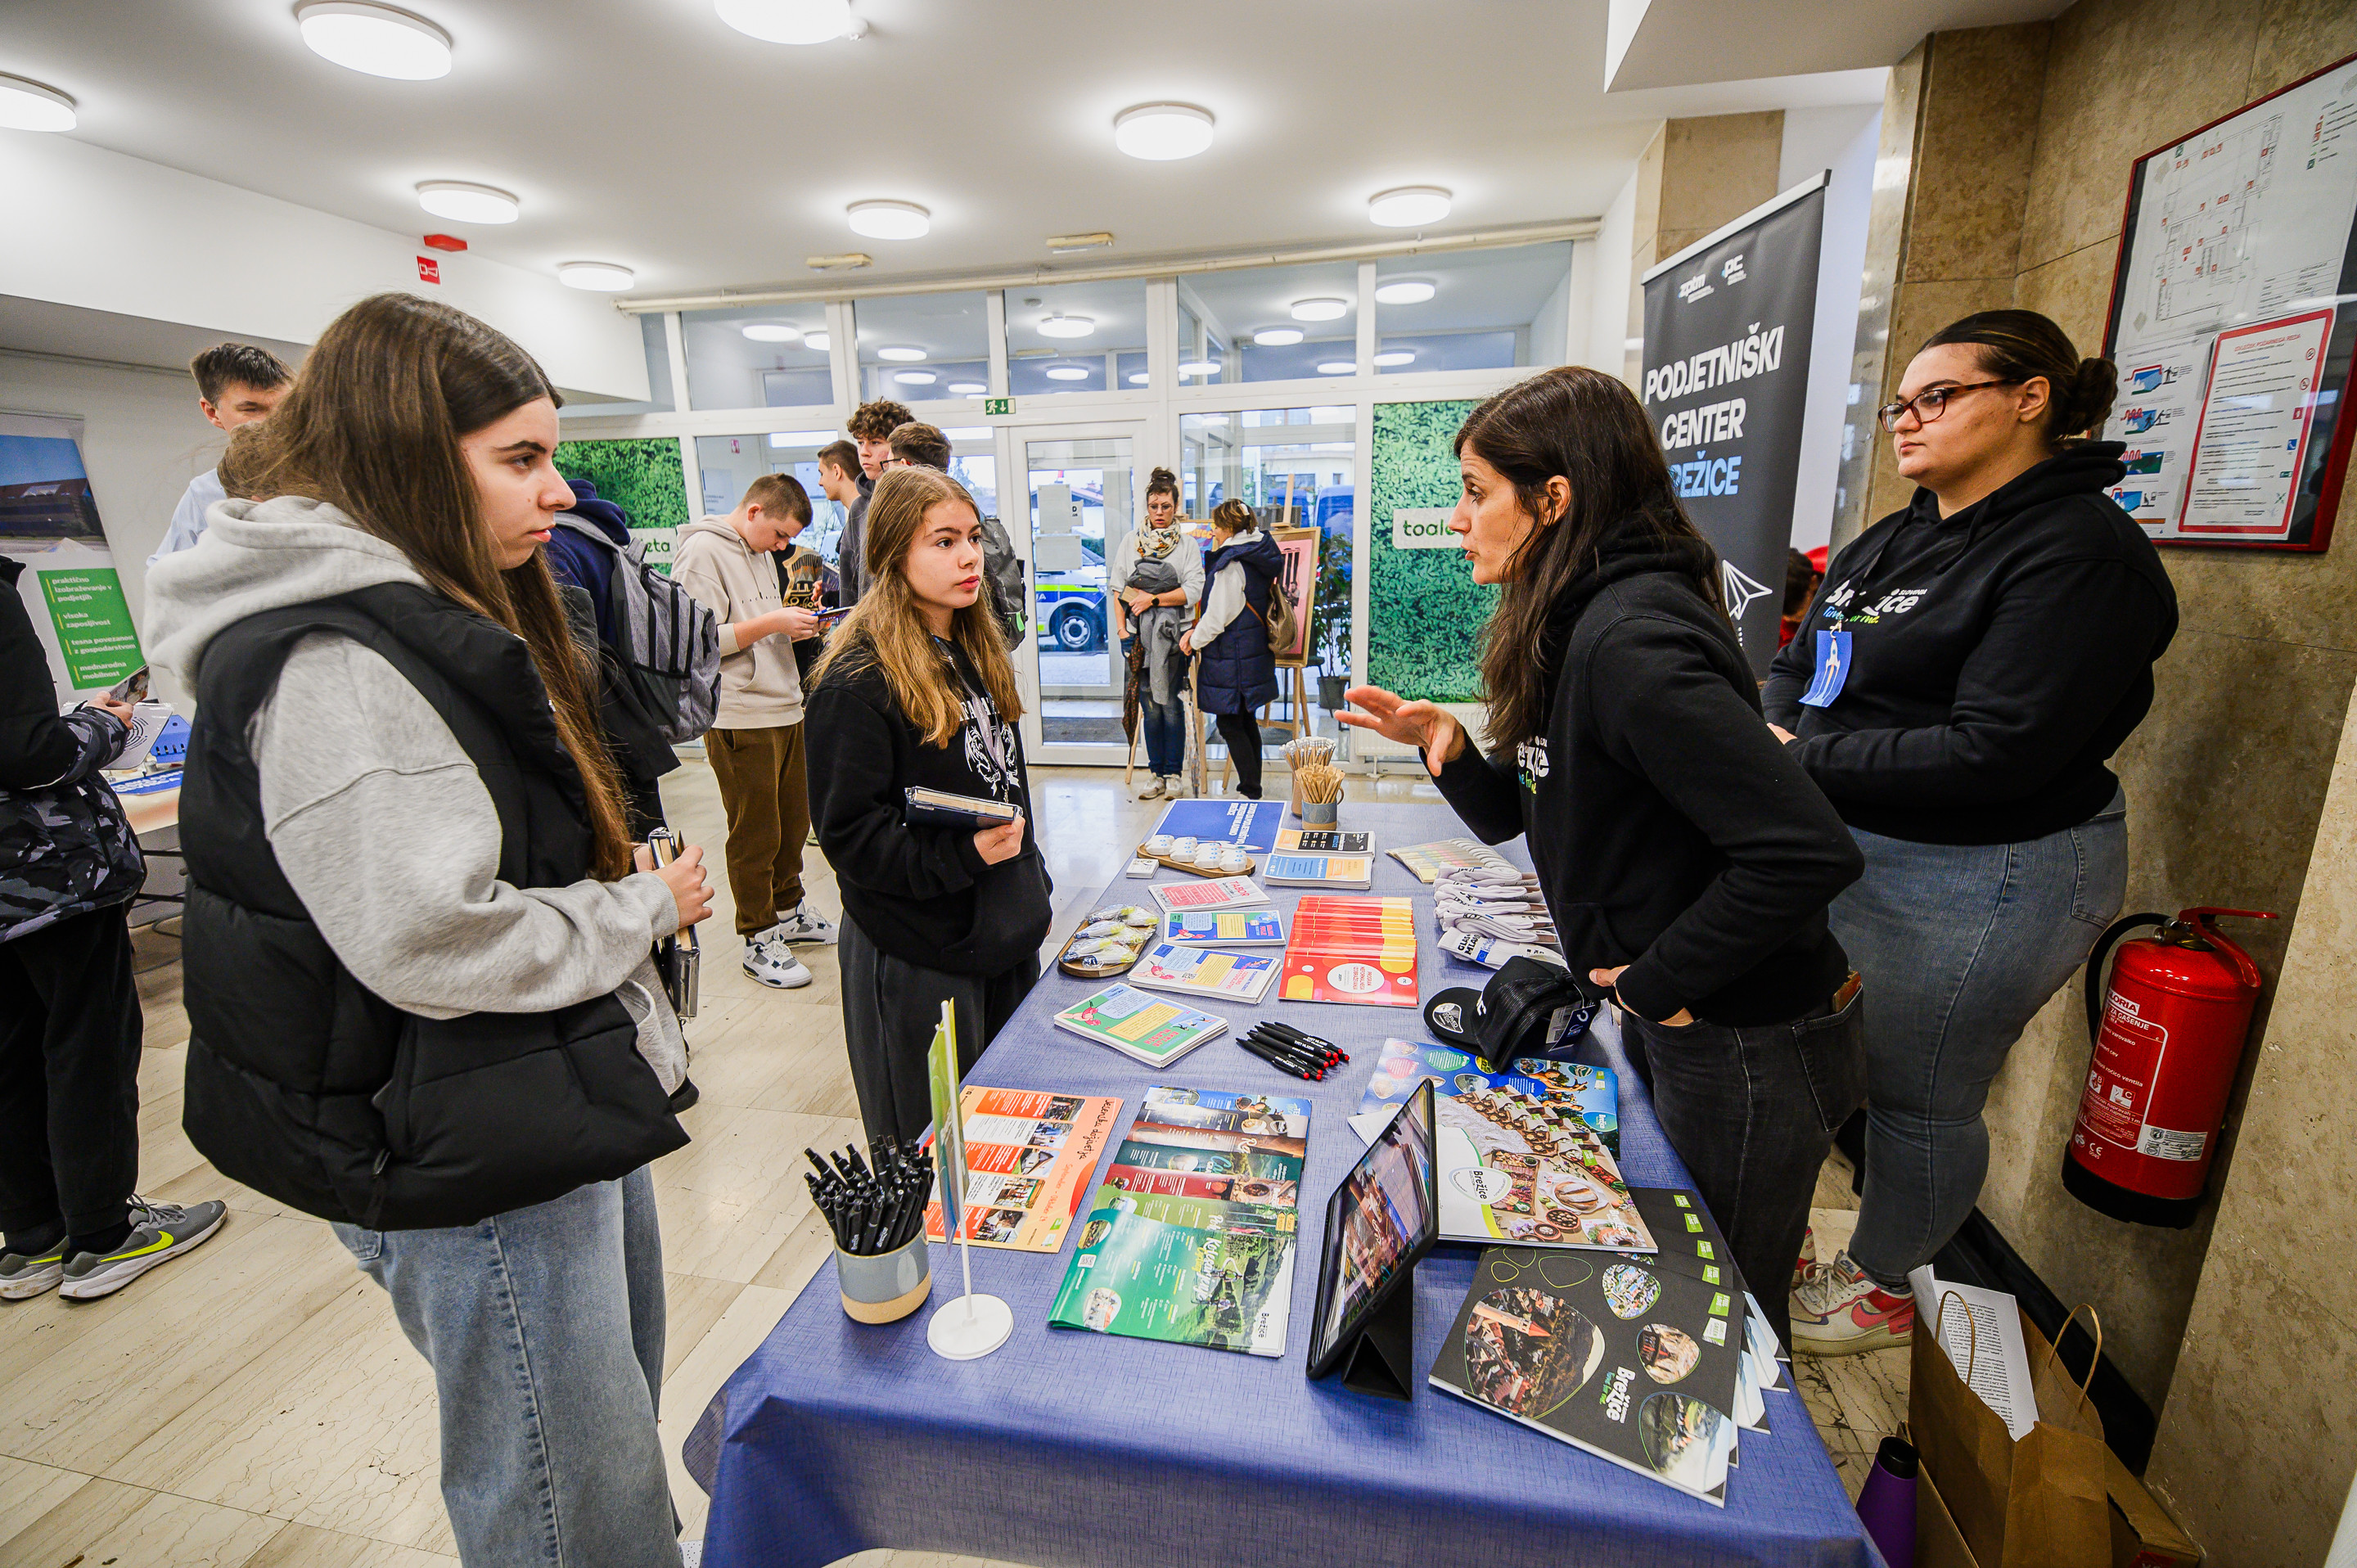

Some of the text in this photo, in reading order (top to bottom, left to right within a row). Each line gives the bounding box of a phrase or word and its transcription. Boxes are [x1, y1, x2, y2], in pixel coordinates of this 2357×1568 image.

[1645, 322, 1785, 405] PODJETNIŠKI
[1661, 398, 1746, 450] CENTER
[1669, 450, 1742, 498] REŽICE
[1403, 518, 1458, 536] toale
[52, 576, 90, 584] praktično
[66, 620, 111, 629] zaposljivost
[93, 634, 134, 644] povezanost
[80, 643, 137, 655] gospodarstvom
[80, 661, 127, 671] mednarodna
[83, 671, 120, 680] mobilnost
[1229, 881, 1251, 897] TABOR
[2108, 991, 2137, 1012] LORIA
[2117, 1013, 2150, 1031] GAŠENJE
[2122, 1075, 2144, 1088] ventila
[2125, 1091, 2133, 1100] C
[1473, 1170, 1488, 1201] Brežice
[1192, 1237, 1223, 1304] Kolesarjenje
[1252, 1312, 1270, 1338] Brežice
[1605, 1366, 1636, 1422] Brežice
